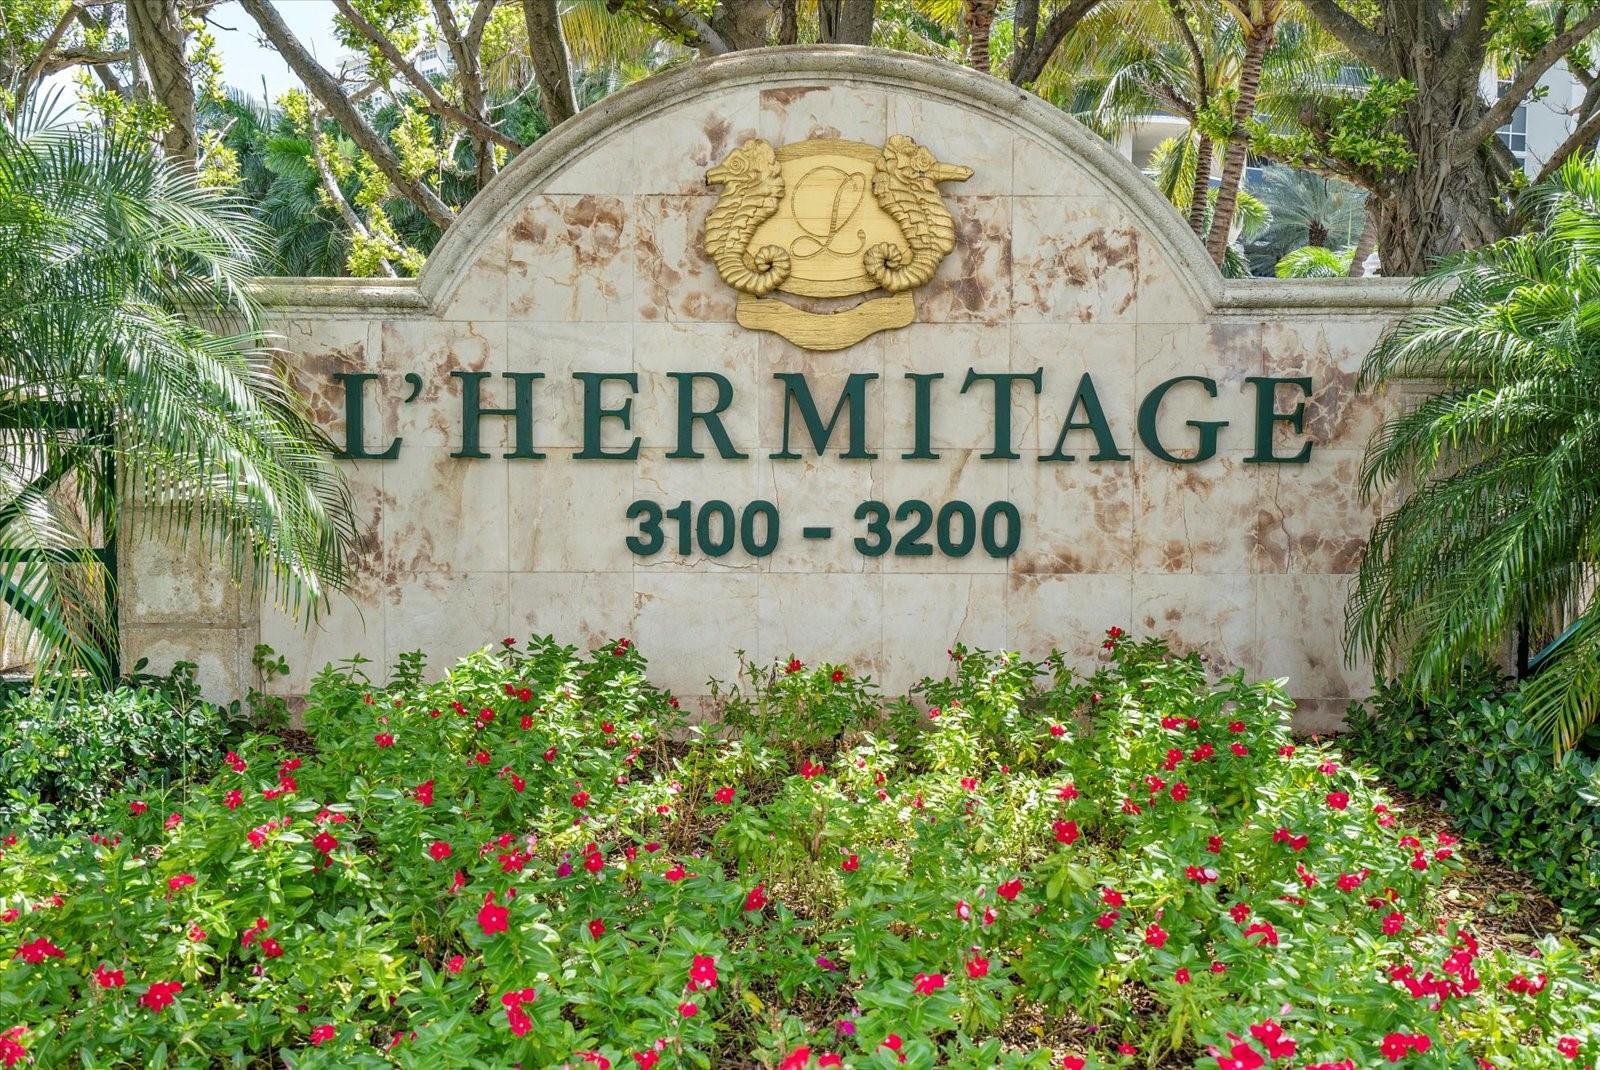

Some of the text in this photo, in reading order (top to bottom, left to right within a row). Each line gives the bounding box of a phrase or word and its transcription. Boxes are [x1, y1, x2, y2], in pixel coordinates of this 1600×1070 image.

[332, 368, 1314, 464] L'HERMITAGE
[626, 499, 1022, 559] 3100 - 3200
